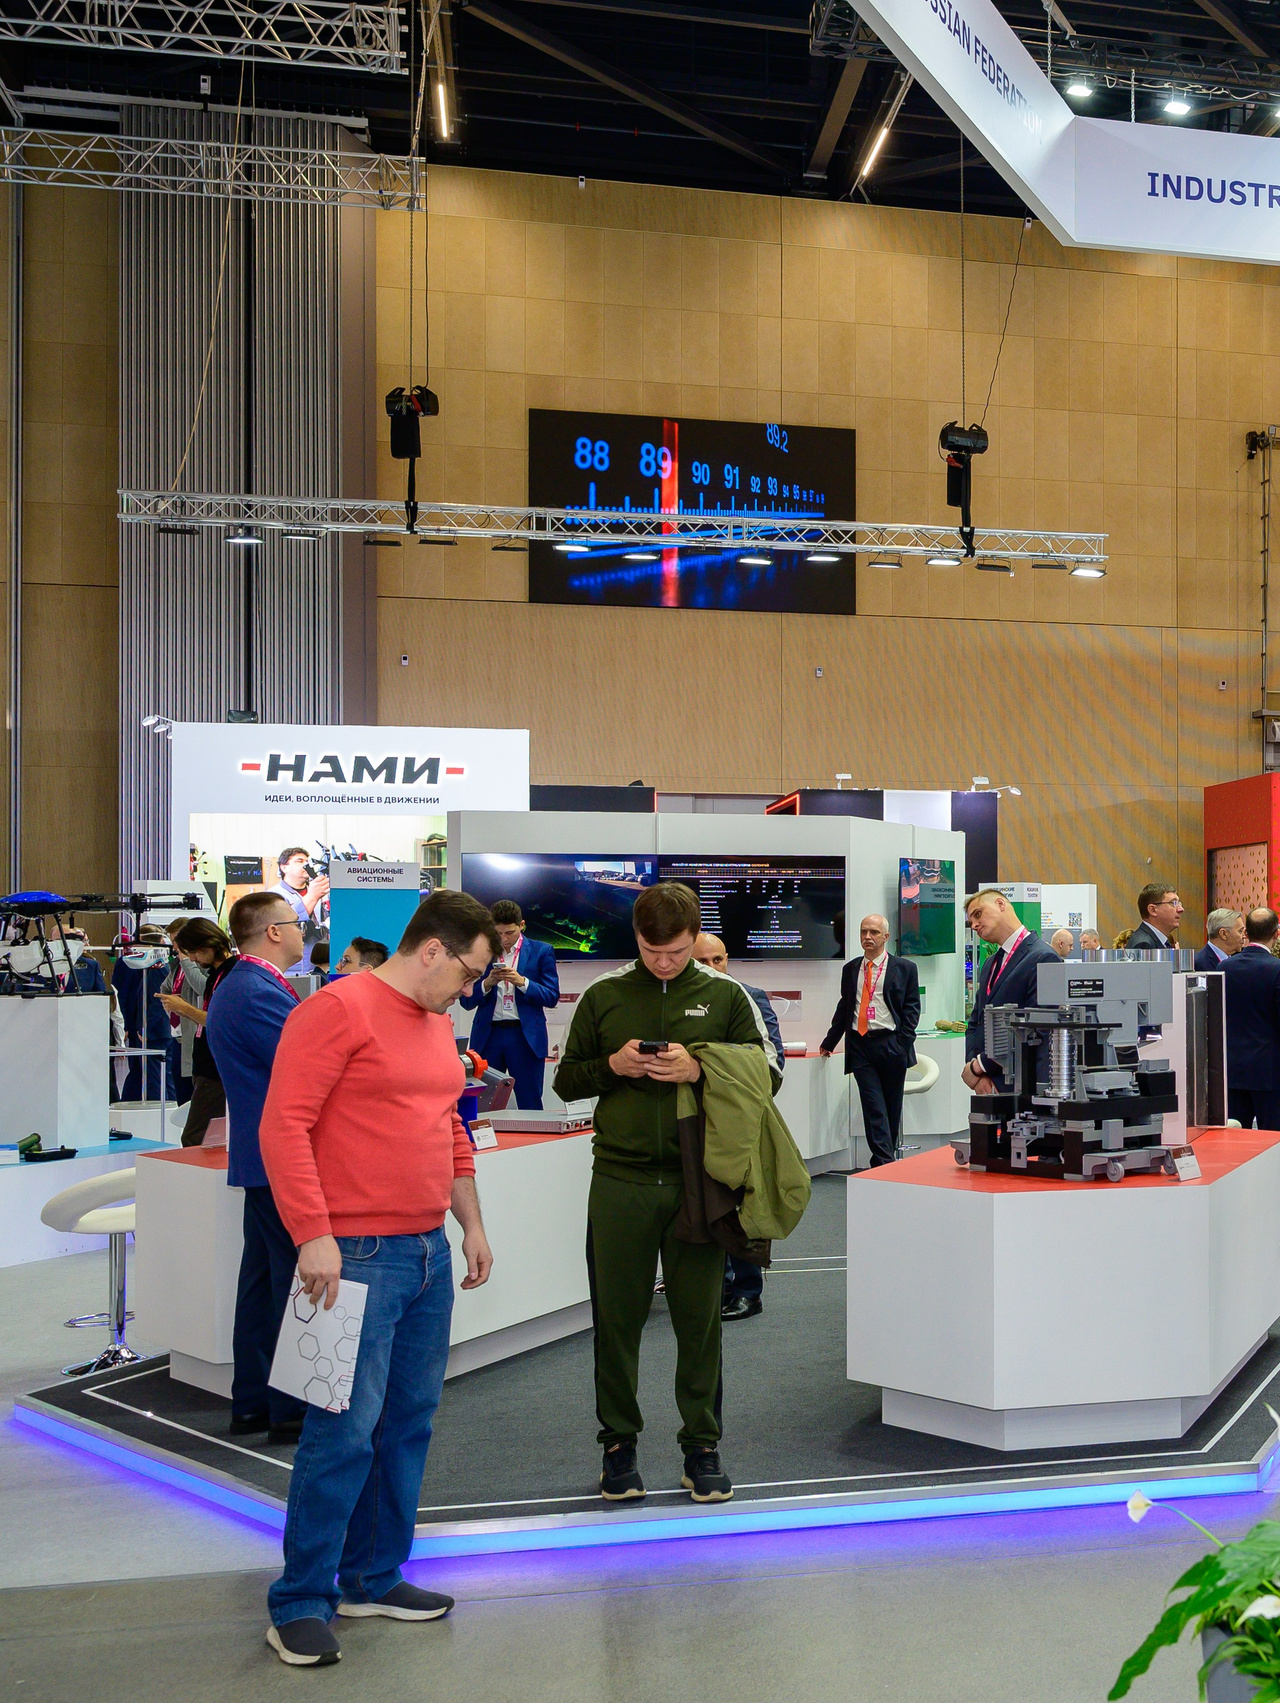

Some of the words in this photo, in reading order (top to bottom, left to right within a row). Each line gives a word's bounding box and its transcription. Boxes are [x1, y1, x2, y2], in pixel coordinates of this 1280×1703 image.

[925, 0, 971, 56] SSIAN
[974, 34, 1043, 145] FEDERATION
[766, 423, 789, 453] 89.2
[574, 436, 610, 472] 88
[639, 442, 672, 479] 89
[691, 461, 710, 486] 90
[723, 463, 740, 490] 91
[750, 475, 761, 494] 92
[767, 476, 778, 496] 93
[266, 753, 441, 785] НАМИ
[264, 795, 294, 803] ИДЕИ,
[296, 793, 374, 804] ВОПЛОЩЁННЫЕ
[384, 796, 440, 805] ДВИЖЕНИИ
[347, 867, 404, 876] АВИАЦИОННЫЕ
[685, 1009, 706, 1017] PUMA
